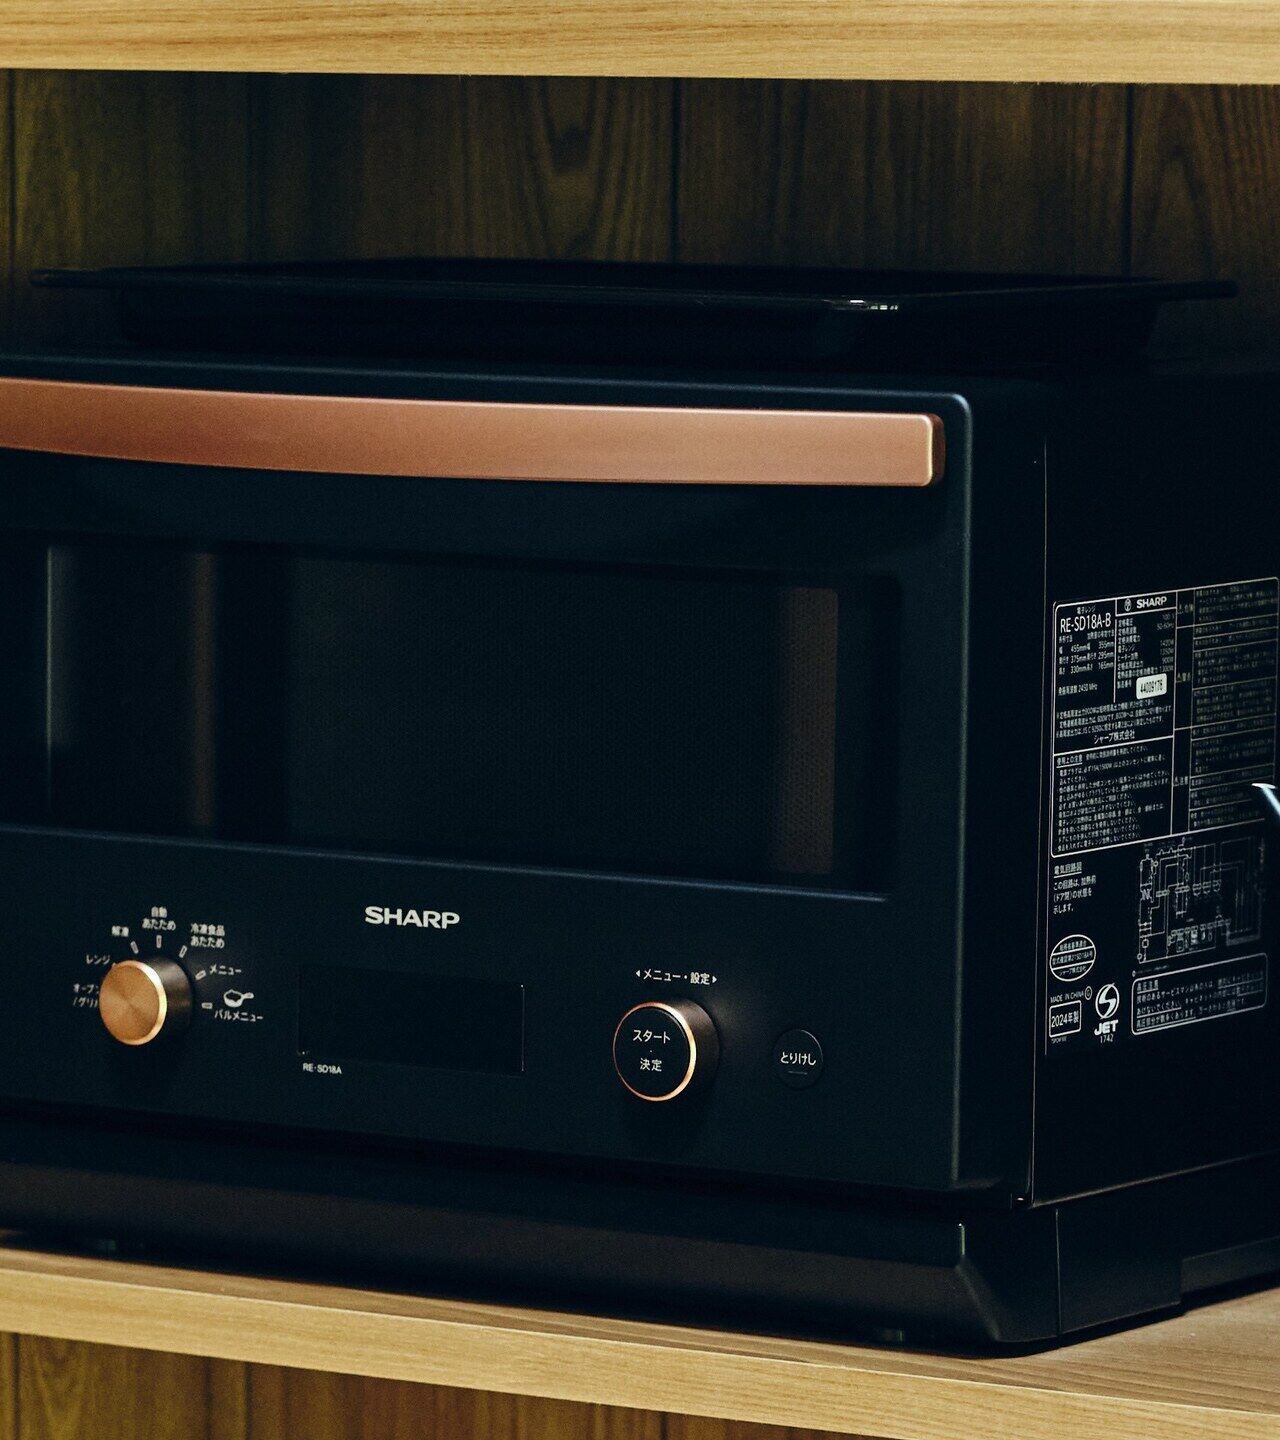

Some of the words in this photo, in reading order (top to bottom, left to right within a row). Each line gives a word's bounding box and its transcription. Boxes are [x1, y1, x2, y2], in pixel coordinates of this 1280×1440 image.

[1136, 596, 1167, 609] SHARP
[1060, 612, 1112, 633] RE-SD18A-B
[1093, 729, 1135, 745] シャープ株式会社
[141, 918, 177, 932] あたため
[364, 905, 460, 930] SHARP
[190, 936, 226, 949] あたため
[85, 953, 111, 965] レンジ
[209, 963, 242, 976] メニュー
[1050, 994, 1063, 1004] MADE
[1070, 990, 1084, 999] CHINA
[1051, 1010, 1080, 1028] 2024年製
[1093, 1019, 1119, 1036] JET
[632, 1029, 671, 1044] スタート
[1100, 1034, 1114, 1044] 1742
[639, 1057, 662, 1072] 決定
[780, 1052, 817, 1067] とりけし
